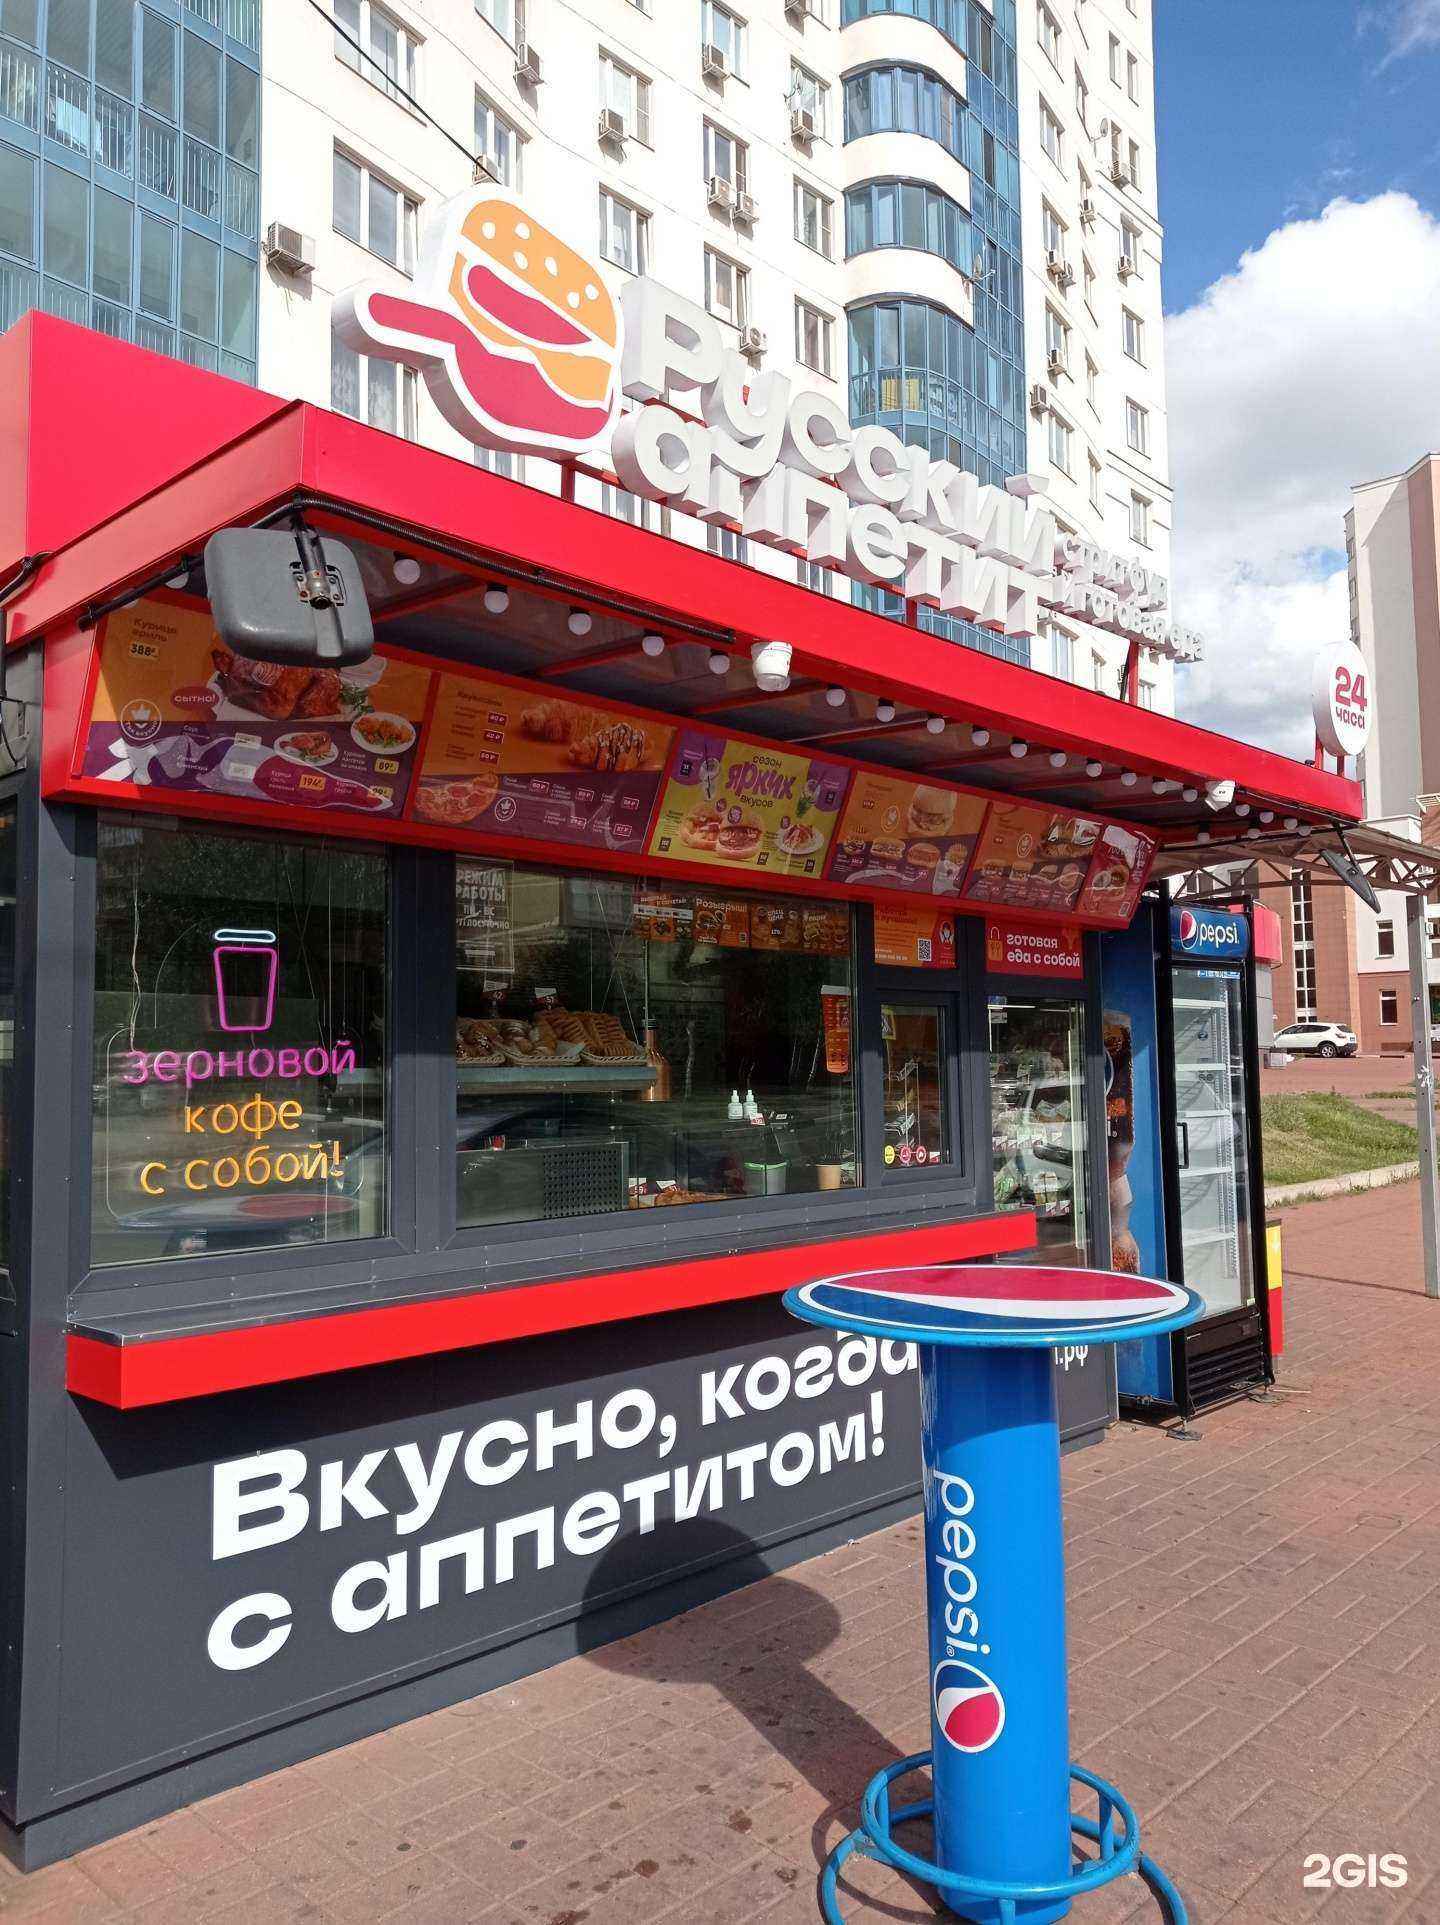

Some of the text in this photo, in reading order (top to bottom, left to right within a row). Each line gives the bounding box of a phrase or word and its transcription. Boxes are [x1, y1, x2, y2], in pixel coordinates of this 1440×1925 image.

[621, 276, 1056, 577] Русский
[611, 405, 1054, 638] аппетит
[133, 618, 177, 634] Курица
[1335, 666, 1367, 711] 24
[1335, 706, 1365, 729] часа
[725, 761, 797, 800] ЯРКИХ
[752, 754, 782, 768] сезон
[740, 794, 774, 808] вкусов
[456, 885, 506, 902] РАБОТЫ
[1006, 934, 1058, 949] готовая
[1200, 922, 1239, 949] pepsi
[1006, 950, 1080, 967] еда с собой
[123, 1040, 356, 1088] зерновой
[185, 1093, 303, 1140] кофе
[140, 1140, 345, 1195] с собой!
[211, 1330, 919, 1561] Вкусно, когда
[206, 1390, 888, 1672] с аппетитом!
[933, 1470, 991, 1655] pepsi
